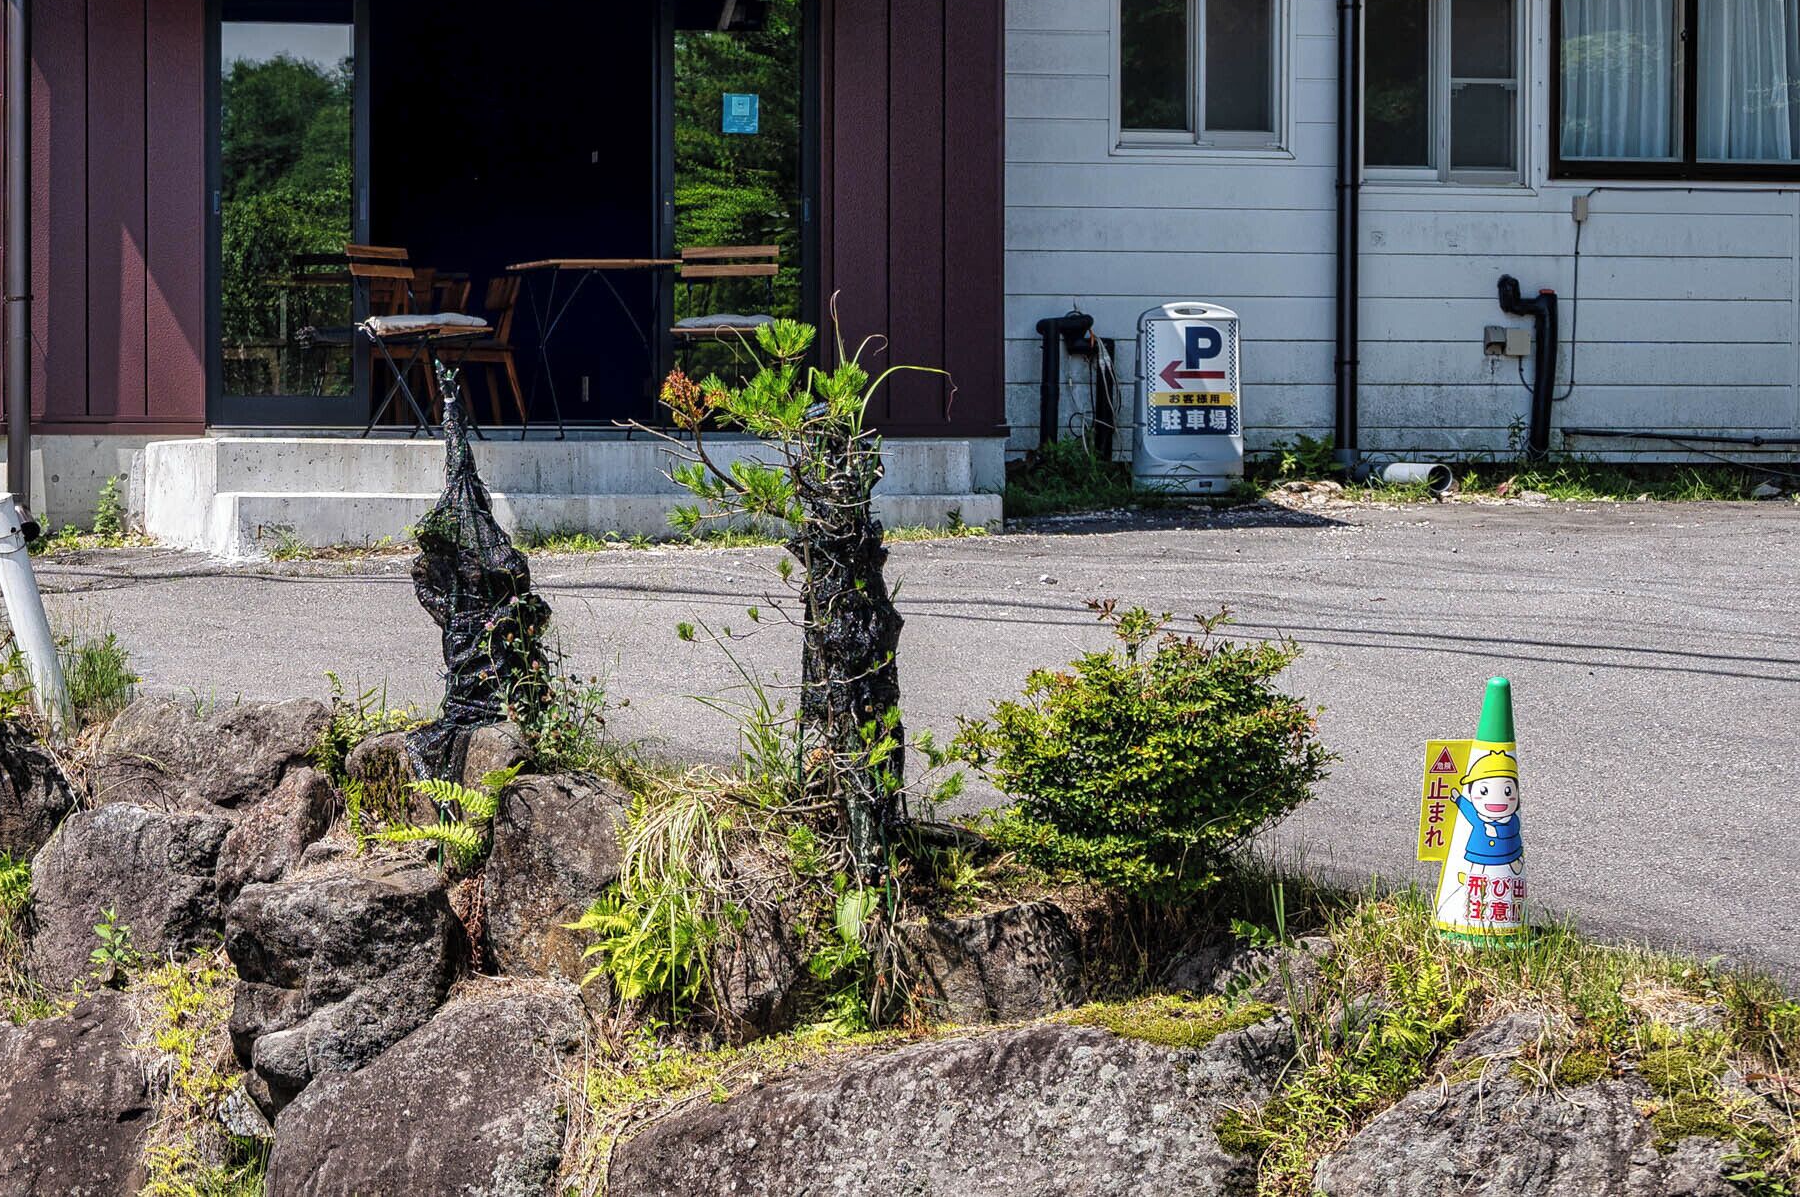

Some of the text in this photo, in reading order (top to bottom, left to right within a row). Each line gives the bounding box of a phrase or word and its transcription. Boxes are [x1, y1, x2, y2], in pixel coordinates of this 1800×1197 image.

[1185, 326, 1222, 370] P
[1169, 394, 1220, 404] お客様用
[1161, 409, 1228, 431] 駐車場
[1424, 776, 1449, 848] 止まれ
